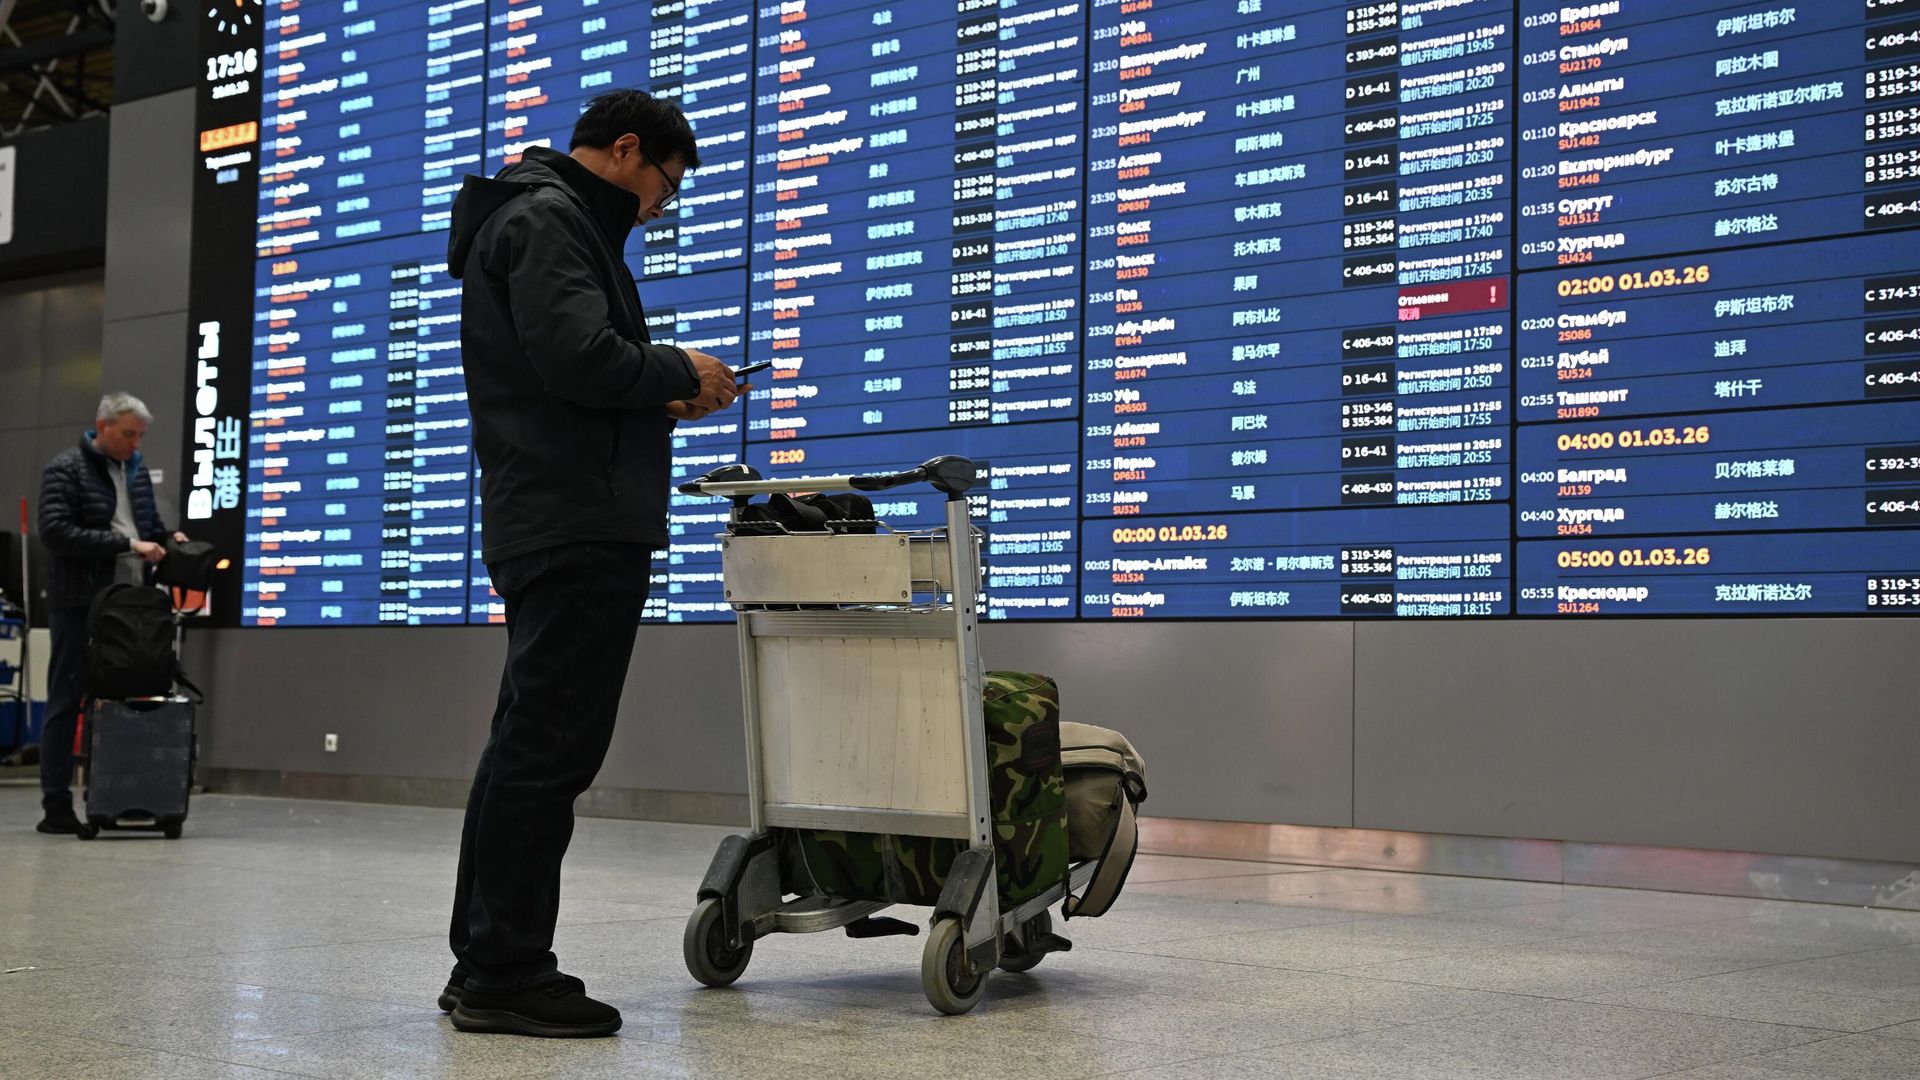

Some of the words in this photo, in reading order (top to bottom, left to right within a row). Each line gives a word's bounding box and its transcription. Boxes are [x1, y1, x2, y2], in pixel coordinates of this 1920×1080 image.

[1524, 12, 1557, 27] 01:00
[1561, 1, 1619, 23] Ереван
[1560, 19, 1601, 35] SU1964
[1716, 8, 1795, 37] 伊斯坦布尔
[1523, 50, 1556, 65] 01:05
[1560, 38, 1628, 62] Стамбул
[1866, 38, 1875, 49] C
[207, 48, 257, 80] 17:16
[1346, 53, 1353, 62] C
[1560, 57, 1601, 73] SU2170
[1716, 51, 1778, 77] 阿拉木图
[1236, 66, 1260, 84] 广州
[1346, 88, 1355, 98] D
[1359, 82, 1390, 96] 16-41
[1523, 88, 1556, 103] 01:05
[1559, 78, 1623, 100] Алматы
[1559, 96, 1600, 111] SU1942
[1716, 82, 1843, 116] 克拉斯诺亚尔斯克
[1345, 124, 1353, 134] C
[1355, 118, 1396, 132] 406-430
[1523, 126, 1556, 141] 01:10
[1559, 109, 1656, 138] Красноярск
[1559, 135, 1600, 149] SU1482
[1716, 130, 1794, 155] 叶卡捷琳堡
[1345, 159, 1354, 170] D
[1358, 154, 1389, 168] 16-41
[1522, 164, 1555, 178] 01:20
[1559, 146, 1673, 175] Екатеринбург
[1559, 173, 1600, 188] SU1448
[1715, 173, 1778, 196] 苏尔古特
[1345, 195, 1354, 206] D
[1357, 190, 1389, 204] 16-41
[1522, 202, 1555, 216] 01:35
[1559, 196, 1613, 217] Сургут
[1865, 206, 1874, 217] C
[1559, 211, 1599, 226] SU1512
[1715, 214, 1778, 236] 赫尔格达
[953, 248, 960, 258] D
[962, 244, 988, 256] 12-14
[1522, 241, 1555, 254] 01:50
[1558, 234, 1624, 254] Хургада
[1558, 251, 1592, 264] SU424
[1344, 268, 1351, 277] C
[1353, 263, 1394, 276] 406-430
[1558, 276, 1614, 296] 02:00
[1619, 266, 1709, 290] 01.03.26
[1398, 293, 1448, 306] Отменен
[1714, 294, 1793, 317] 伊斯坦布尔
[951, 311, 959, 321] D
[961, 308, 986, 320] 16-41
[1233, 308, 1280, 326] 阿布扎比
[1521, 317, 1555, 330] 02:00
[1558, 310, 1626, 331] Стамбул
[1088, 325, 1114, 336] 23:50
[1115, 318, 1174, 336] Абу-Даби
[1559, 329, 1591, 341] 2S086
[1343, 340, 1350, 349] C
[1352, 336, 1393, 348] 406-430
[1398, 330, 1462, 343] Регистрация
[1464, 337, 1492, 351] 17:50
[1866, 333, 1875, 343] C
[1715, 340, 1746, 357] 迪拜
[1088, 359, 1113, 370] 23:50
[1115, 352, 1186, 368] Самарканд
[1521, 356, 1554, 368] 02:15
[1557, 349, 1608, 370] Дубай
[1343, 375, 1352, 385] D
[1355, 372, 1387, 384] 16-41
[1558, 368, 1592, 379] SU524
[1866, 375, 1875, 385] C
[1715, 379, 1762, 397] 塔什干
[1088, 392, 1113, 403] 23:50
[1114, 389, 1139, 404] Уфа
[1521, 394, 1554, 406] 02:55
[1557, 390, 1628, 405] Ташкент
[1343, 405, 1350, 415] B
[1352, 402, 1393, 414] 319-346
[1558, 406, 1599, 418] SU1890
[188, 322, 219, 519] Вылеты
[1232, 414, 1267, 431] 阿巴坎
[1343, 418, 1350, 428] B
[1352, 415, 1392, 427] 355-364
[1087, 425, 1112, 436] 23:55
[1114, 422, 1159, 436] Абакан
[1558, 432, 1613, 450] 04:00
[1619, 427, 1709, 447] 01.03.26
[771, 449, 805, 464] 22:00
[1343, 448, 1351, 458] D
[1355, 446, 1387, 457] 16-41
[212, 417, 240, 509] 出港
[1087, 459, 1111, 470] 23:55
[1114, 457, 1155, 471] Пермь
[1715, 459, 1794, 479] 贝尔格莱德
[1521, 472, 1554, 483] 04:00
[1558, 469, 1626, 484] Белград
[1342, 485, 1349, 494] C
[1351, 483, 1392, 493] 406-430
[1558, 485, 1591, 495] JU139
[1086, 493, 1111, 503] 23:55
[1113, 491, 1148, 503] Мале
[1715, 501, 1778, 519] 赫尔格达
[1867, 502, 1876, 512] C
[1521, 510, 1554, 521] 04:40
[1557, 508, 1624, 524] Хургада
[1113, 528, 1156, 543] 00:00
[1159, 525, 1227, 541] 01.03.26
[1559, 523, 1592, 535] SU434
[1342, 551, 1349, 560] B
[1352, 550, 1392, 560] 319-346
[1558, 551, 1614, 567] 05:00
[1619, 548, 1710, 566] 01.03.26
[1085, 560, 1110, 570] 00:05
[1113, 556, 1207, 573] Горно-Алтайск
[1342, 564, 1349, 573] B
[1351, 563, 1392, 573] 355-364
[1084, 594, 1110, 604] 00:15
[1112, 592, 1164, 607] Стамбул
[1341, 594, 1349, 603] C
[1351, 594, 1392, 603] 406-430
[1397, 593, 1462, 603] Регистрация
[1521, 588, 1554, 598] 05:35
[1558, 586, 1648, 602] Краснодар
[1715, 584, 1811, 601] 克拉斯诺达尔
[1464, 603, 1491, 615] 18:15
[1558, 602, 1599, 613] SU1264
